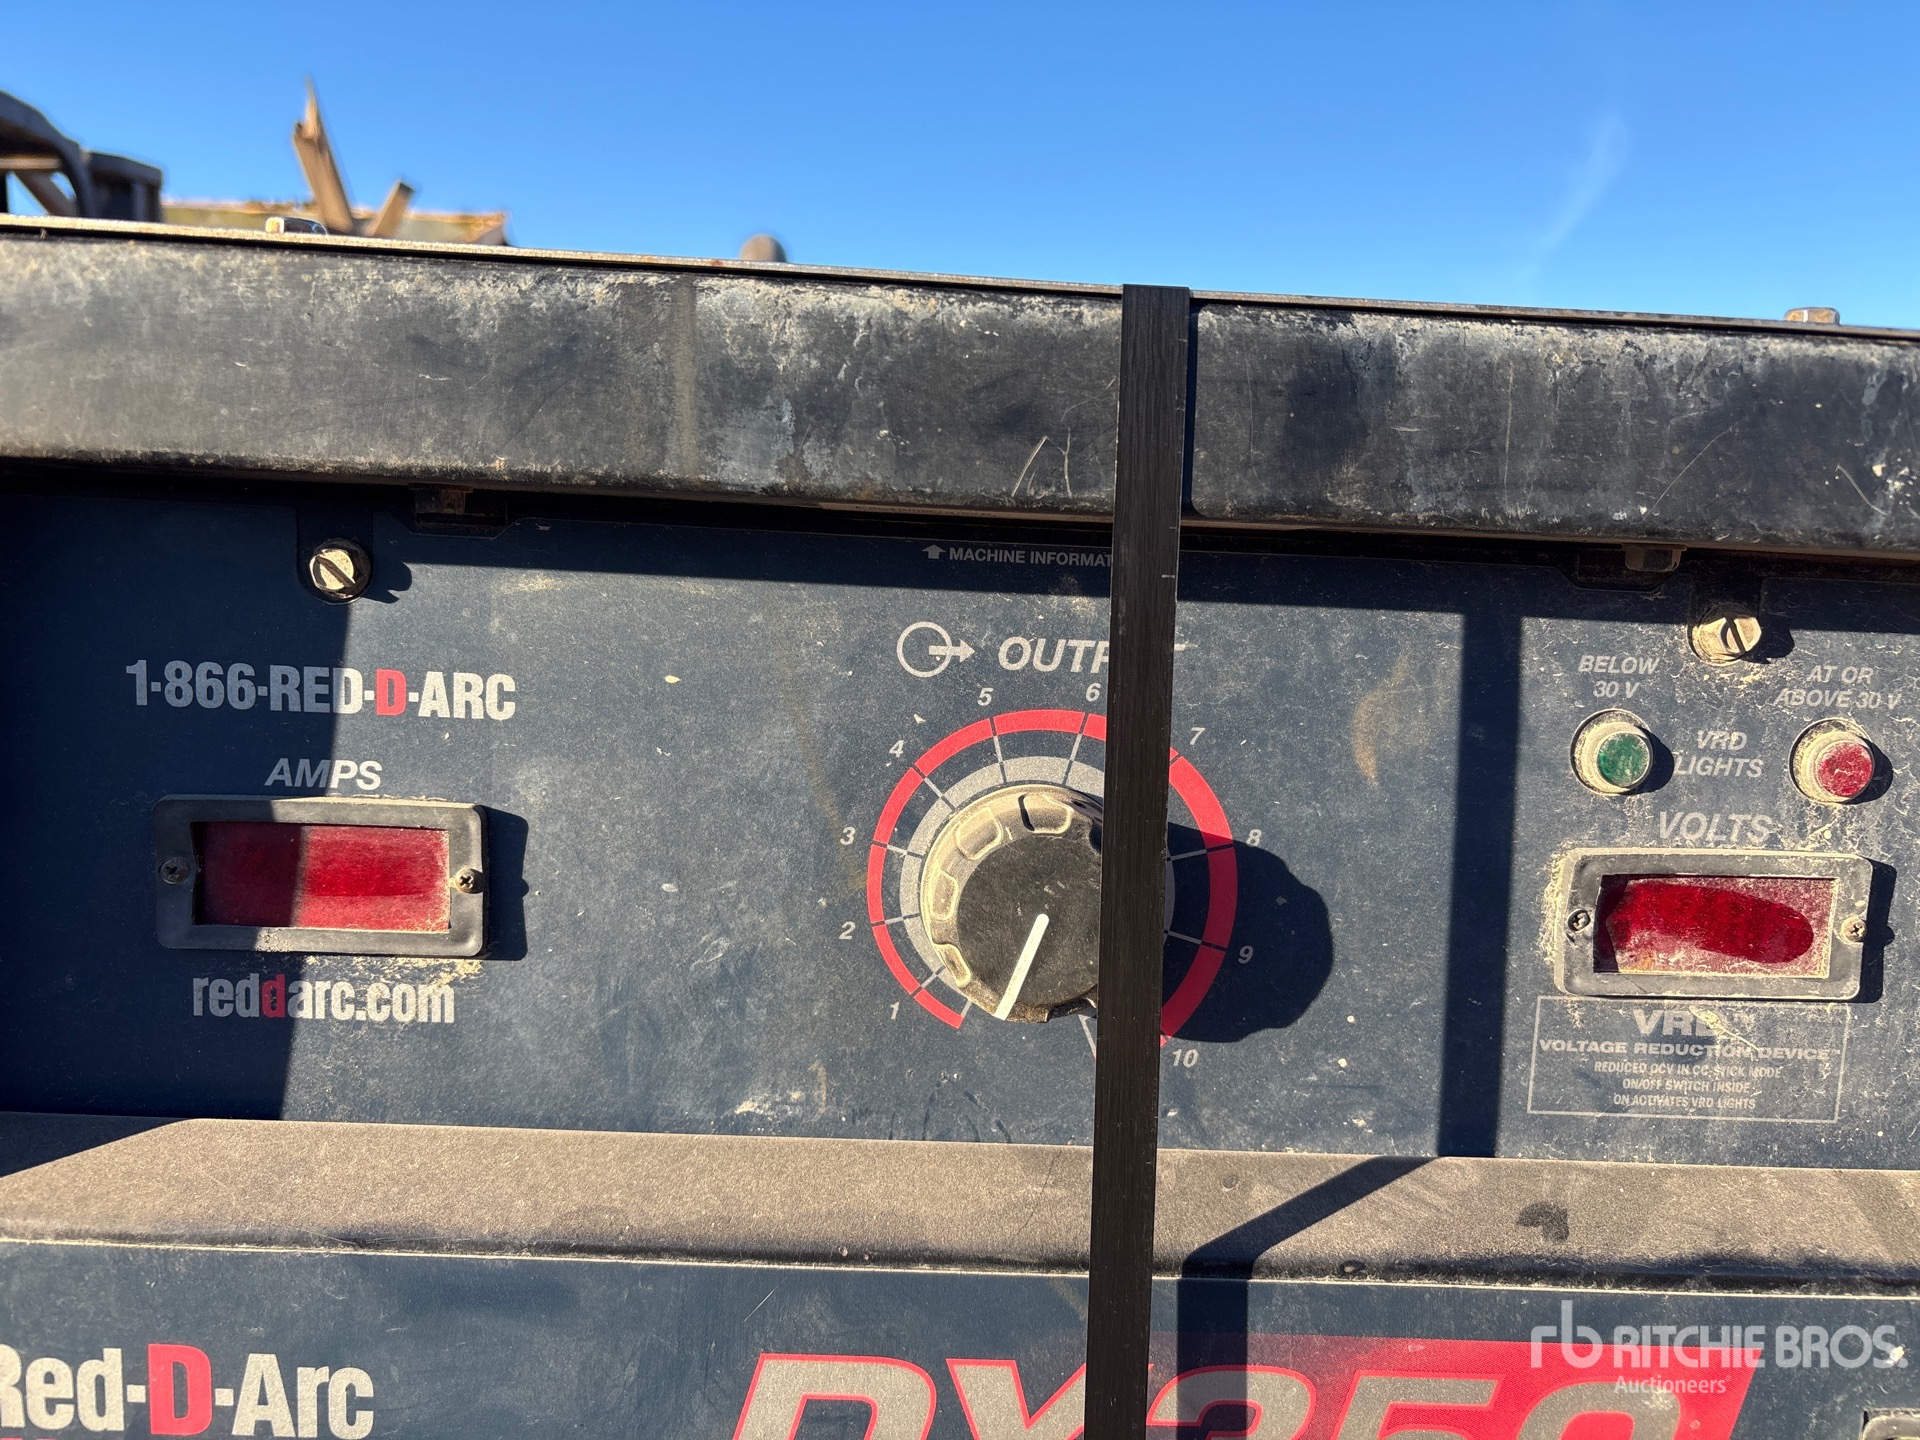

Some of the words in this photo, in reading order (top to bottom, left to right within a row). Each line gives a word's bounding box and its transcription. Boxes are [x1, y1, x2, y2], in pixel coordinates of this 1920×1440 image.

[950, 548, 1026, 564] MACHINE
[1029, 550, 1112, 568] INFORMAT
[998, 636, 1187, 674] OUTP
[1578, 655, 1660, 675] BELOW
[1807, 665, 1837, 684] AT
[1841, 666, 1874, 685] OR
[126, 659, 517, 721] 1-866-RED-D-ARC
[976, 687, 994, 707] 5
[1085, 682, 1101, 702] 6
[1593, 681, 1621, 697] 30
[1624, 681, 1640, 698] V
[1773, 689, 1849, 708] ABOVE
[1854, 691, 1881, 709] 30
[1885, 692, 1903, 710] V
[1190, 727, 1206, 746] 7
[1697, 730, 1748, 750] VRD
[888, 740, 905, 759] 4
[264, 757, 383, 791] AMPS
[1674, 756, 1764, 778] LIGHTS
[839, 827, 856, 846] 3
[1657, 811, 1774, 843] VOLTS
[1247, 829, 1262, 847] 8
[839, 922, 856, 941] 2
[1237, 944, 1254, 964] 9
[191, 973, 456, 1023] reddarc.com
[889, 1001, 900, 1021] 1
[1172, 1047, 1200, 1068] 10
[1539, 1039, 1628, 1054] VOLTAGE
[1633, 1042, 1751, 1058] REDUCTION
[1594, 1061, 1647, 1074] REDUCED
[1622, 1078, 1662, 1090] ON/OFF
[1665, 1080, 1709, 1092] SWITCH
[1713, 1082, 1751, 1094] INSIDE
[1613, 1094, 1631, 1105] ON
[1633, 1095, 1689, 1107] ACTIVATES
[1691, 1097, 1714, 1108] VRD
[1717, 1098, 1756, 1110] LIGHTS
